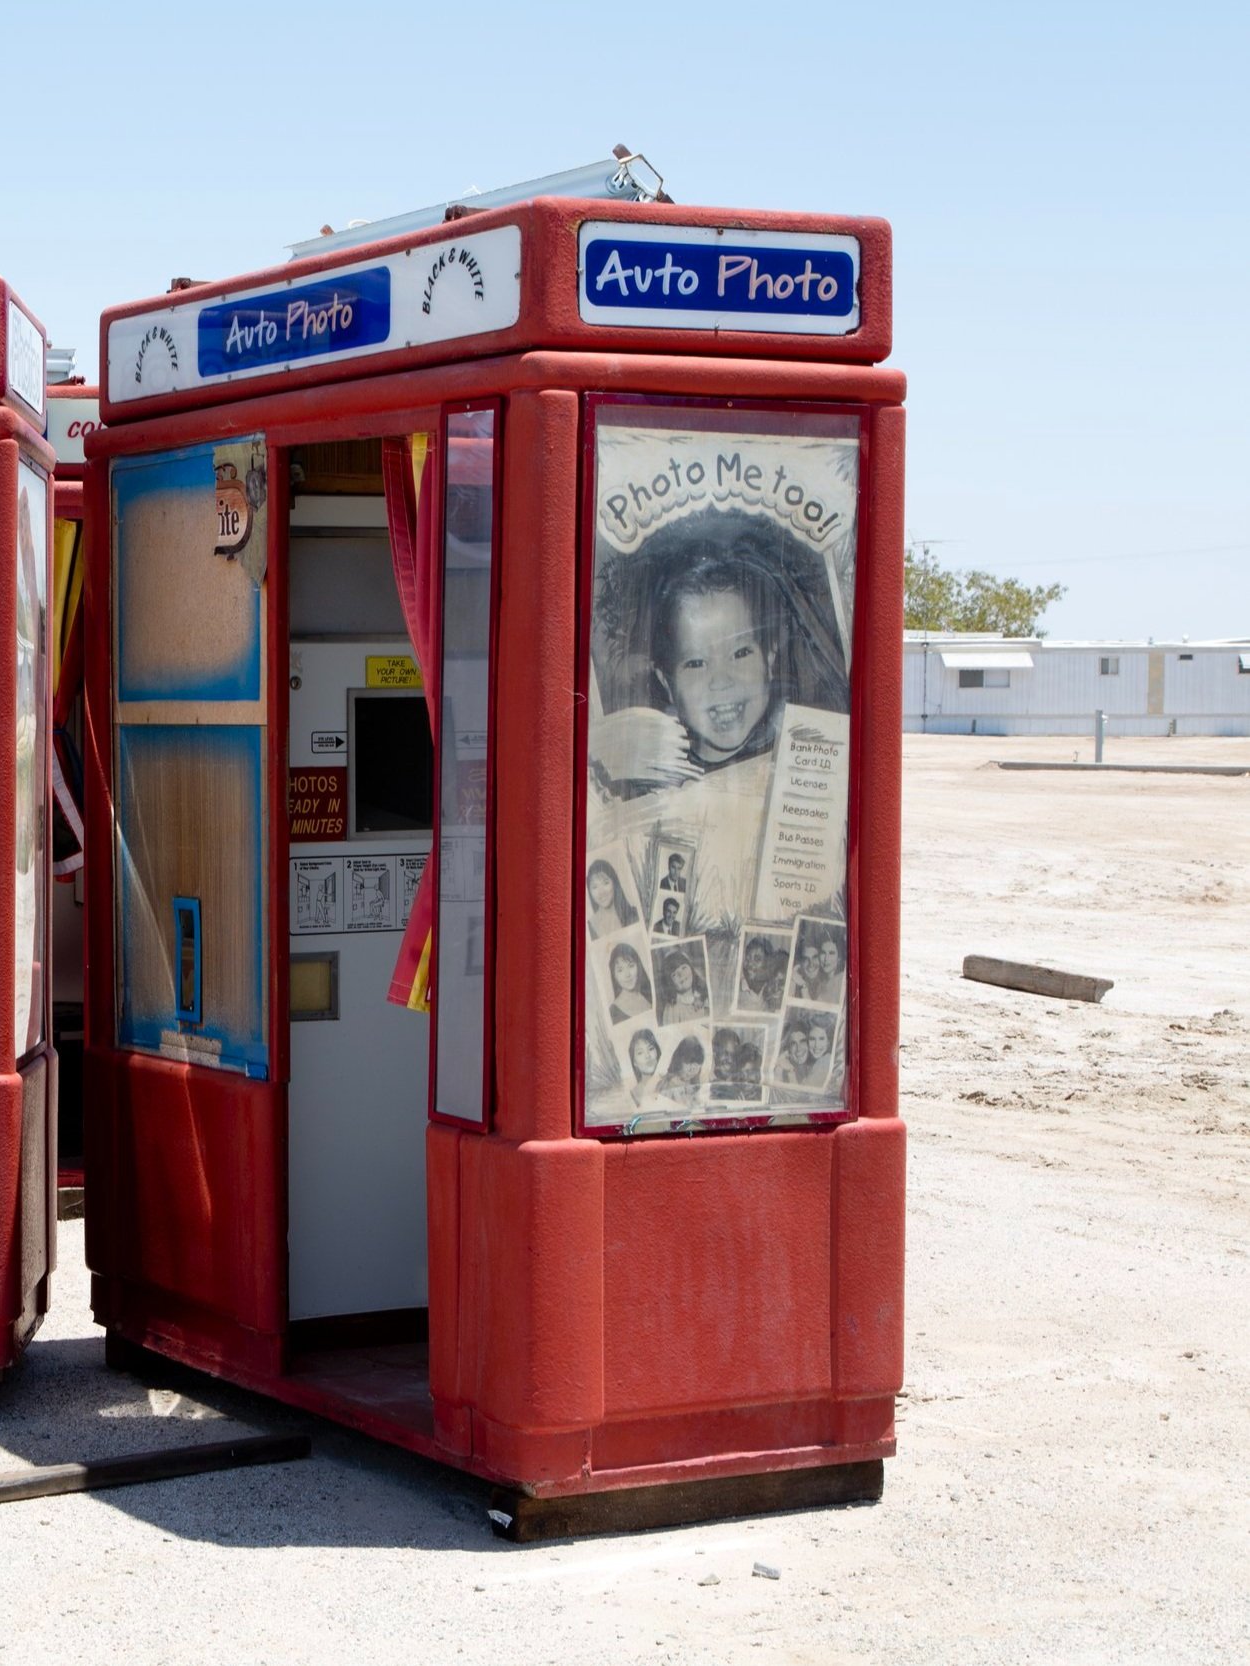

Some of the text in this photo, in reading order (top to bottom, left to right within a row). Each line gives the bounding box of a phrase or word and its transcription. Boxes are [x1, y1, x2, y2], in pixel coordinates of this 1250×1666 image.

[422, 247, 484, 315] BLACK & WHITE
[596, 249, 839, 302] Auto Photo
[225, 292, 353, 355] Auto Photo
[135, 330, 151, 384] BLACK
[159, 327, 179, 373] WHITE
[67, 421, 108, 438] CO
[606, 452, 840, 534] Photo Me too!
[387, 659, 406, 668] TAKE
[376, 668, 417, 677] YOUR OWN
[380, 676, 413, 685] PICTURE!
[790, 741, 840, 757] Bank Photo
[794, 756, 818, 768] Card
[790, 777, 829, 791] Licenses
[327, 798, 341, 813] IN
[782, 803, 829, 820] Keepsakes
[291, 818, 343, 834] MINUTES
[778, 831, 825, 848] Bus Passes
[399, 857, 405, 867] 3
[772, 855, 827, 872] Immigration
[773, 877, 802, 891] Sports
[780, 897, 803, 910] Visas
